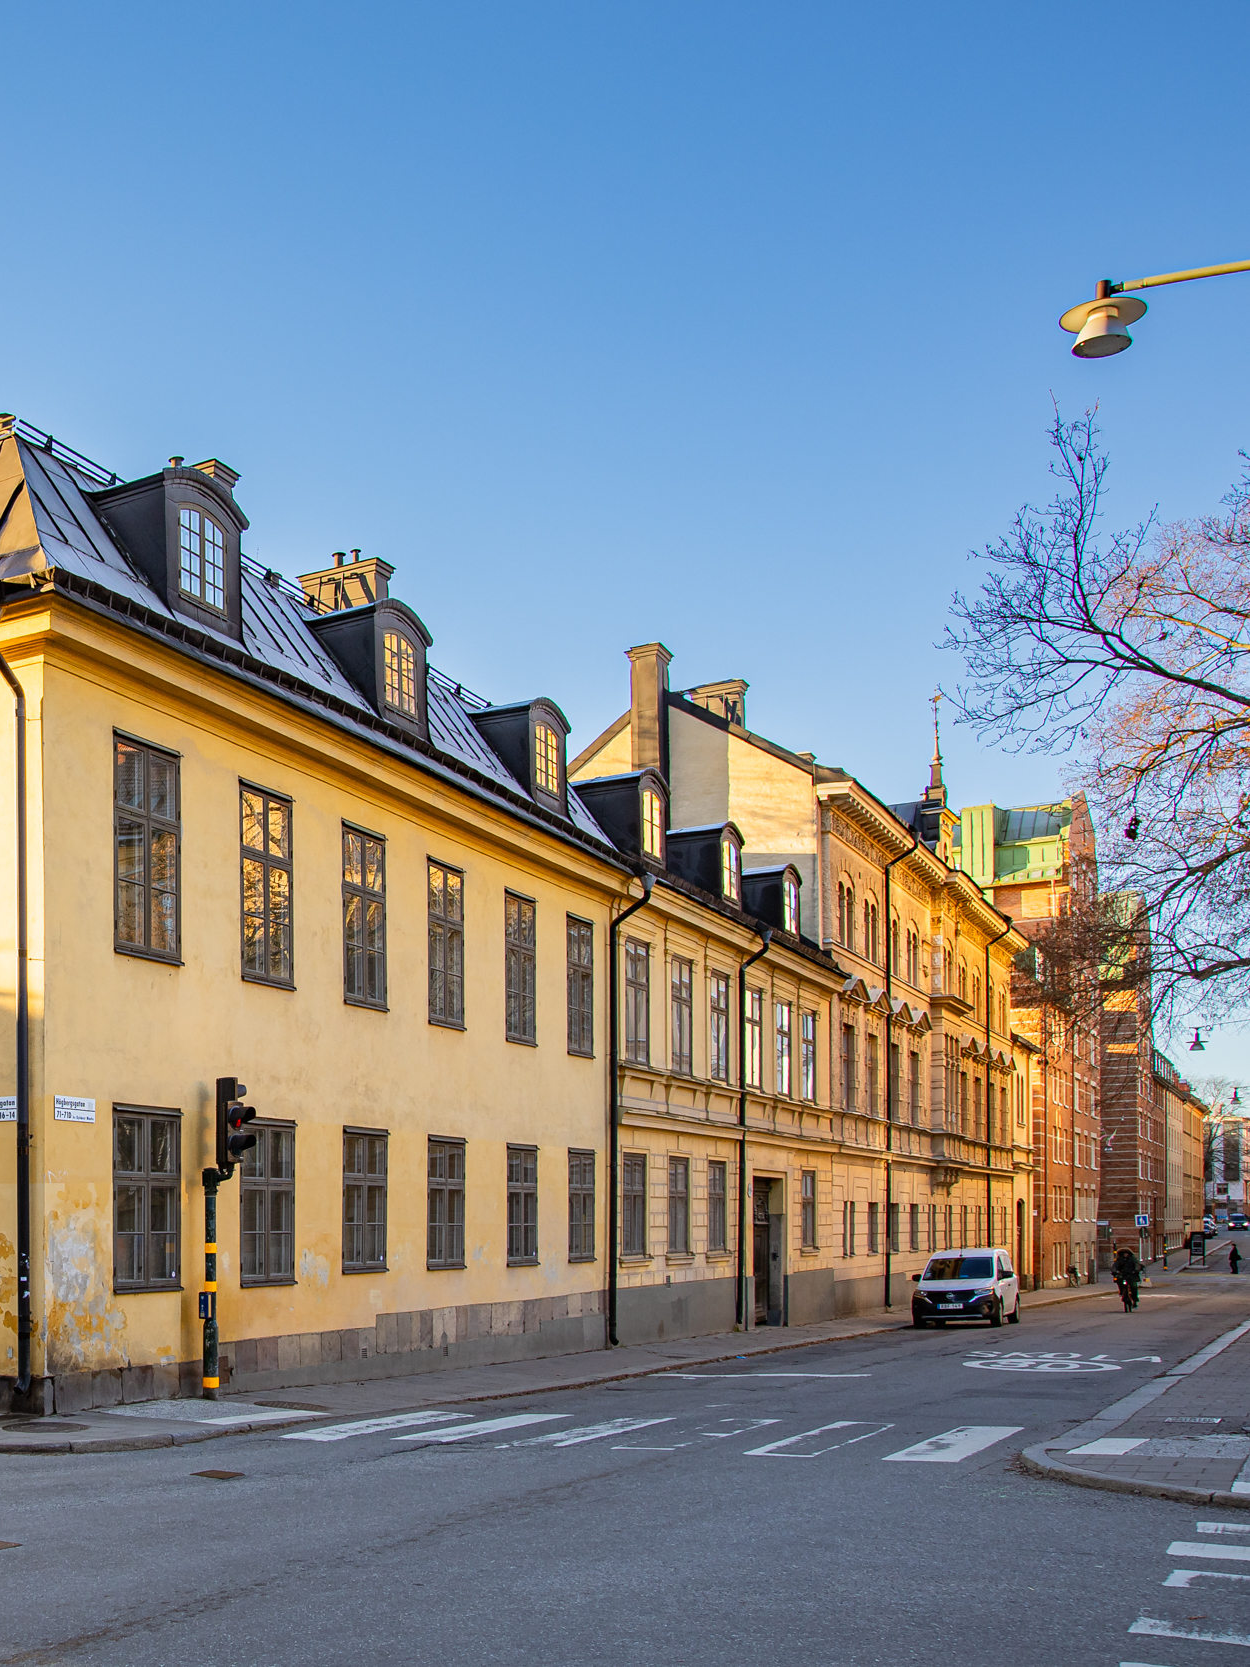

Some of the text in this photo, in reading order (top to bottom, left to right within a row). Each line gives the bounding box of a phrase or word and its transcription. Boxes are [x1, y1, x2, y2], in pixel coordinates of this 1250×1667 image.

[56, 1098, 85, 1108] Högbergsgatan
[0, 1111, 15, 1120] 16-14
[964, 1350, 1161, 1363] SKOLA
[989, 1360, 1081, 1370] 30
